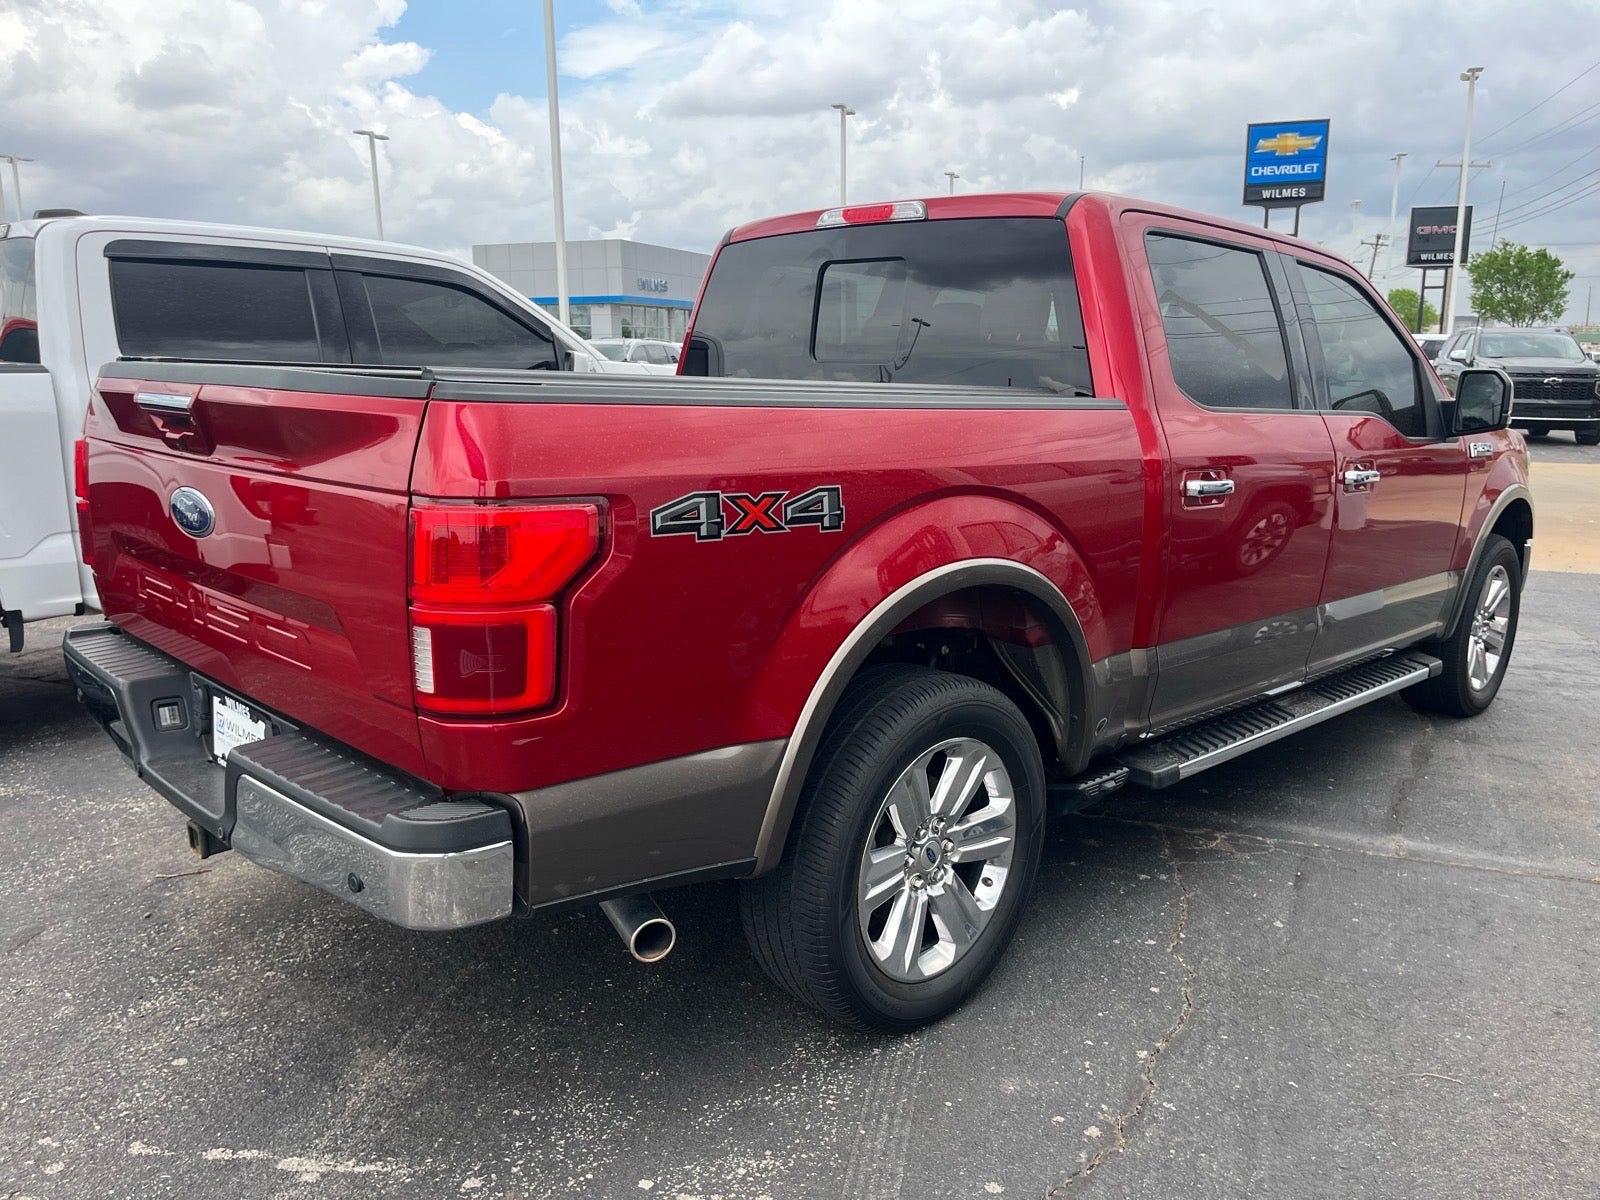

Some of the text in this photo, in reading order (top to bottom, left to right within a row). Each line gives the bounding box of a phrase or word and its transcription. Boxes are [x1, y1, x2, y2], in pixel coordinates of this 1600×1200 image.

[1251, 163, 1319, 176] CHEVROLET
[1262, 188, 1306, 199] WILMES
[1420, 252, 1455, 261] WILMES
